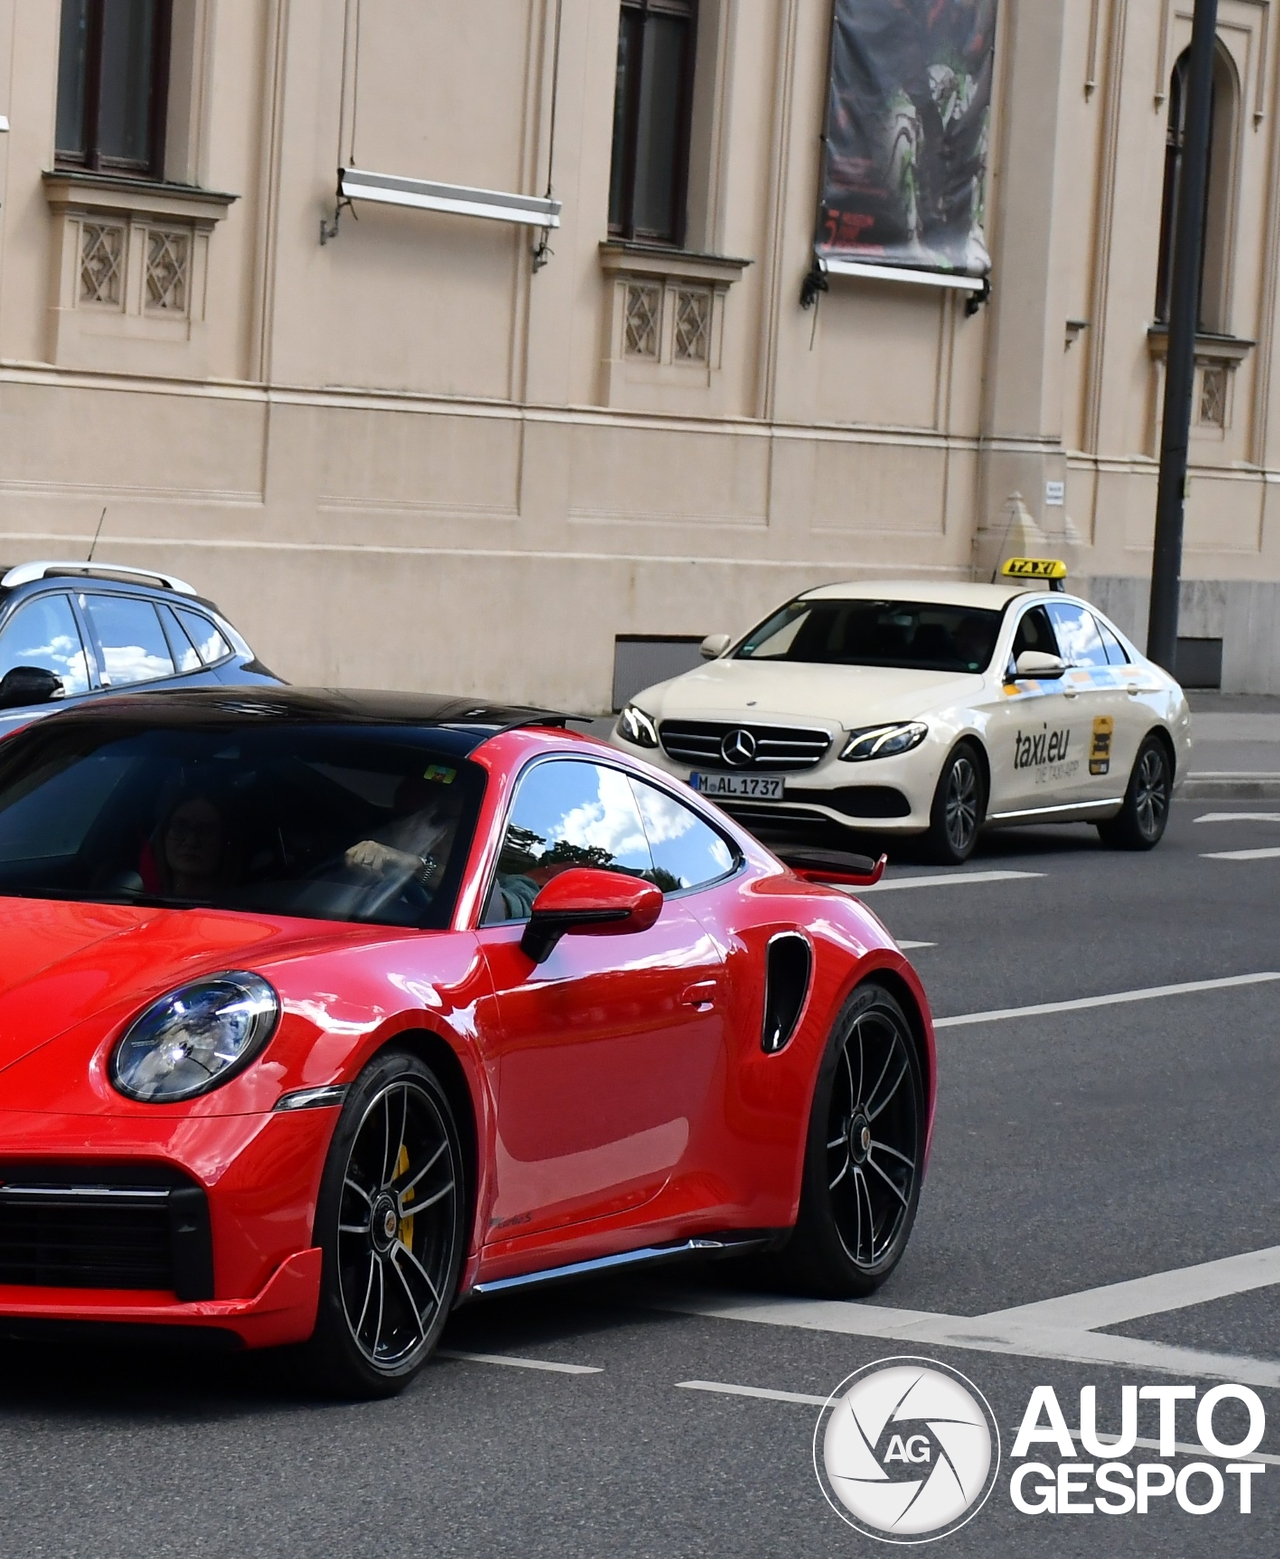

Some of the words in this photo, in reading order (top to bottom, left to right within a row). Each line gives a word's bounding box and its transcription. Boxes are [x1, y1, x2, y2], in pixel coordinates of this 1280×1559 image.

[1013, 561, 1056, 574] TAXI
[1014, 722, 1070, 769] taxi.eu
[699, 776, 708, 791] M
[718, 777, 737, 793] AL
[740, 779, 780, 796] 1737
